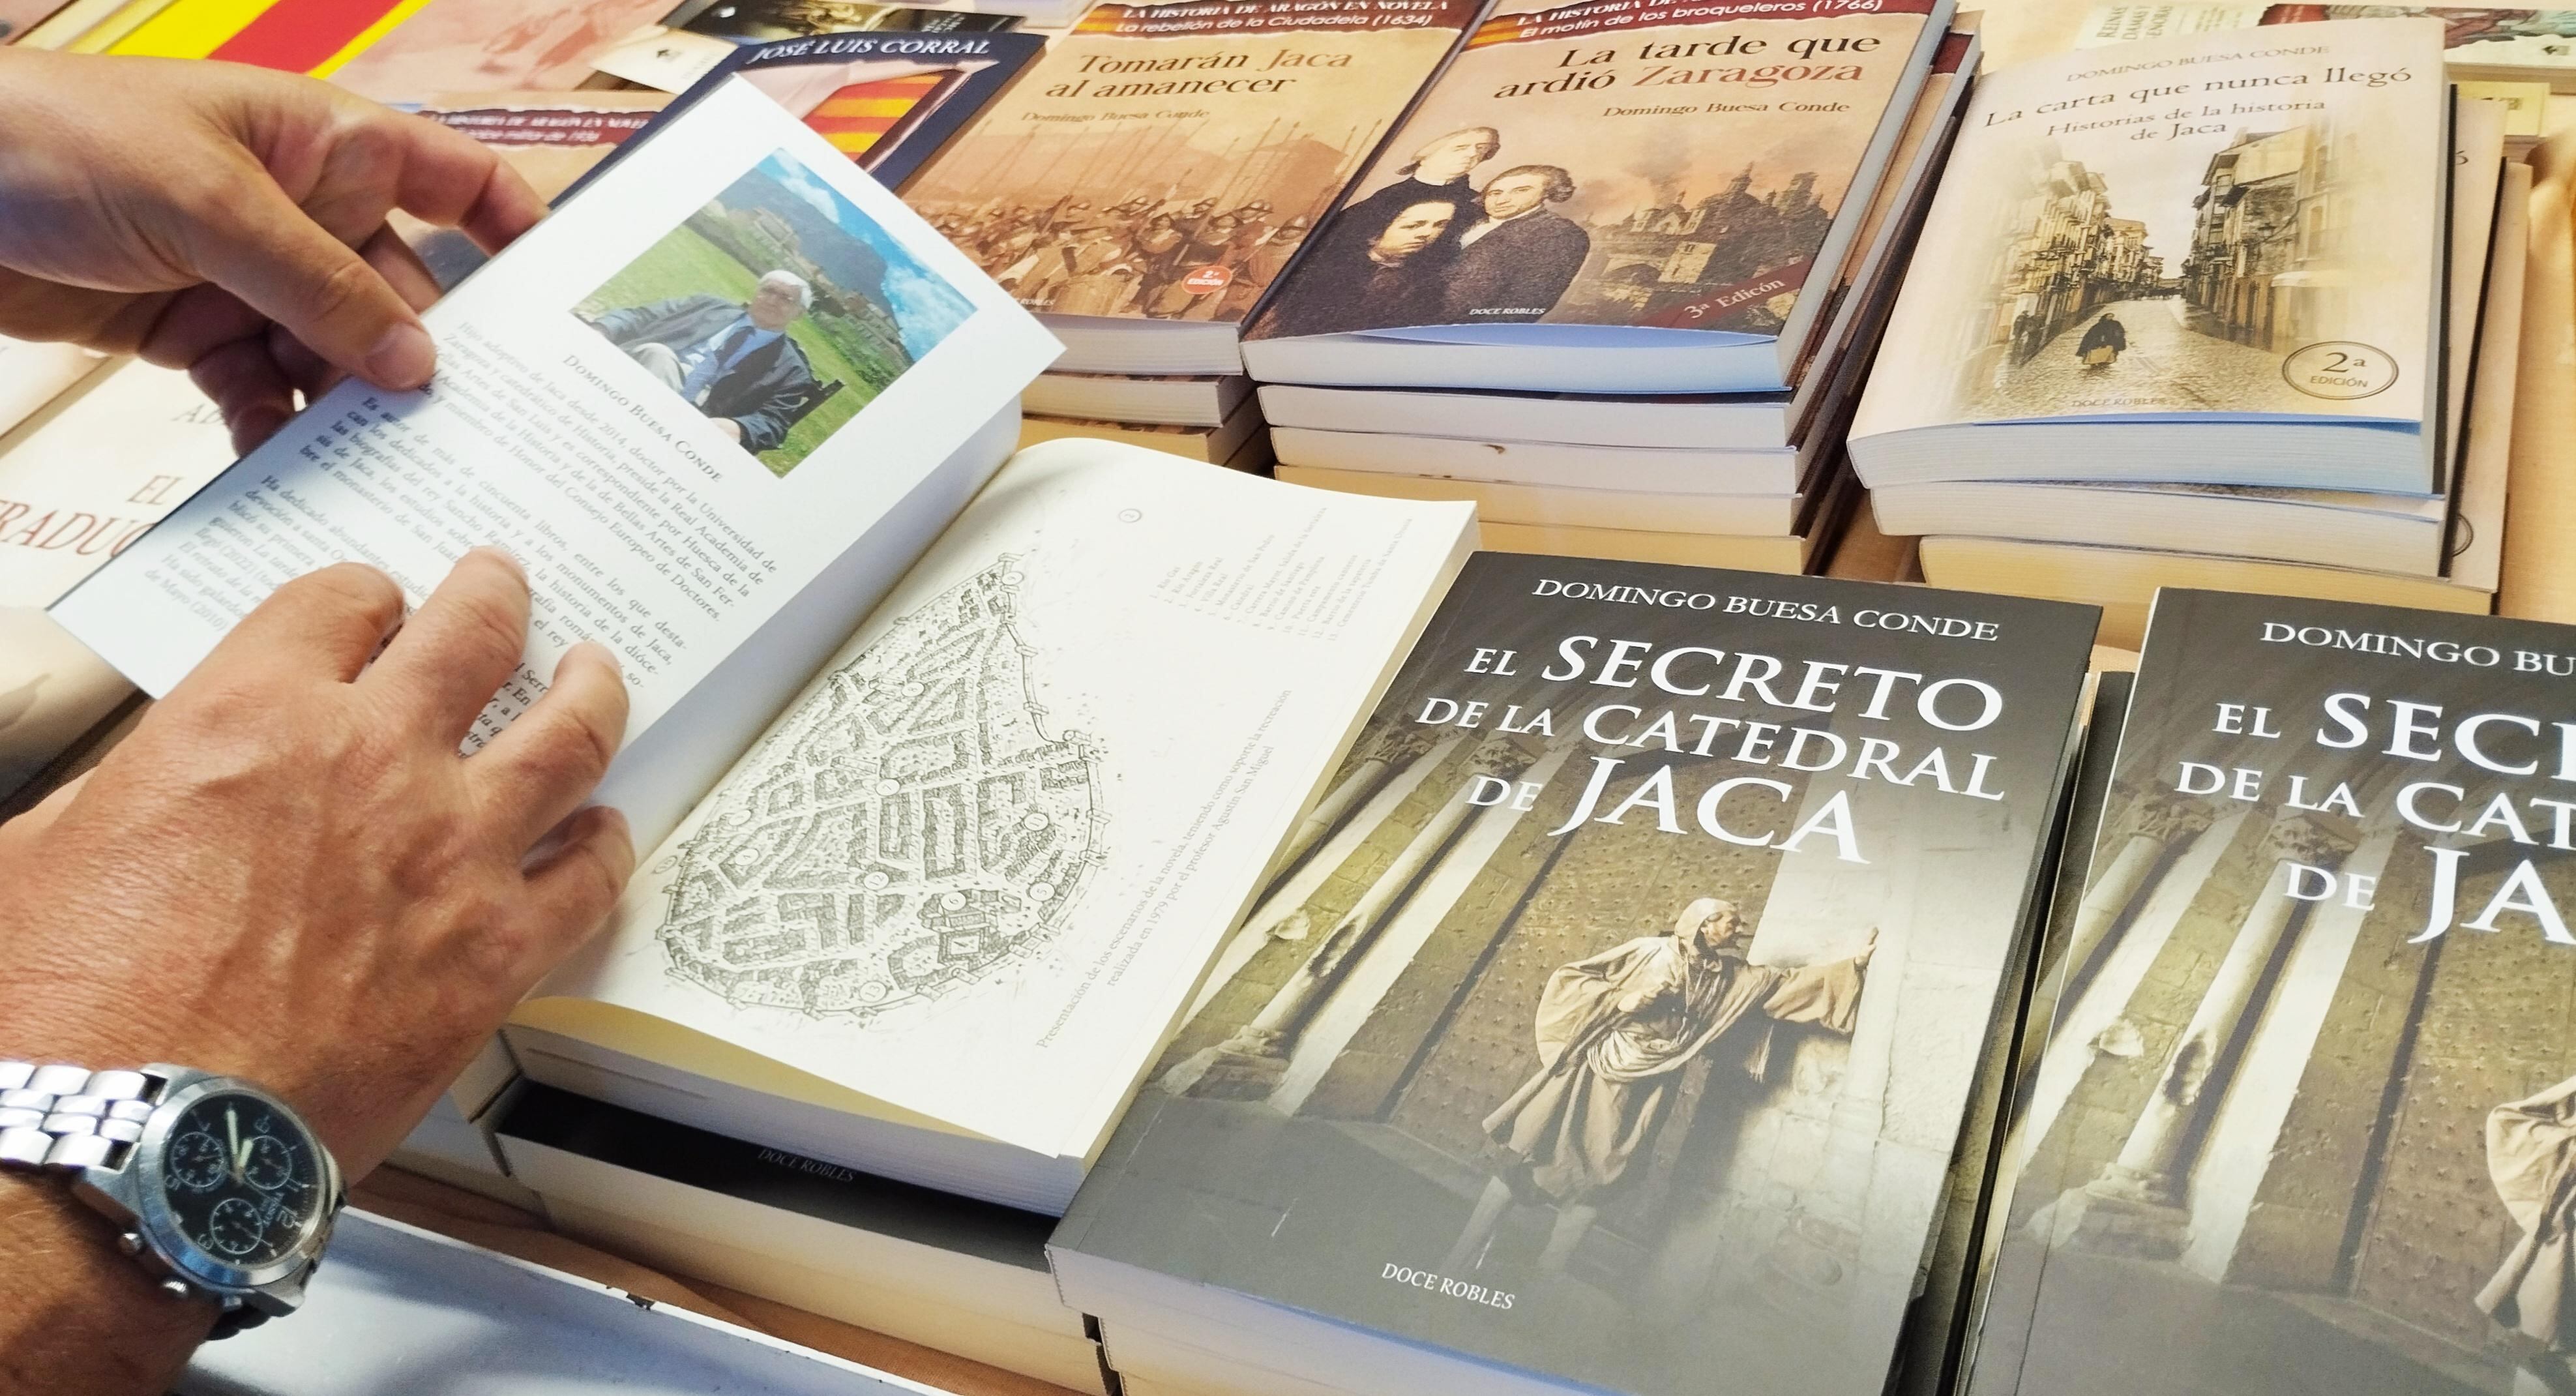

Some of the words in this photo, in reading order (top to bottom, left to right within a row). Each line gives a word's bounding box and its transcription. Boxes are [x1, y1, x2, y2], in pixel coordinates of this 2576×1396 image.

[1141, 20, 1213, 32] rebelión
[1217, 19, 1243, 28] de
[1245, 18, 1265, 27] la
[1268, 14, 1369, 26] Ciudadela
[1372, 14, 1432, 27] (1634)
[1151, 7, 1228, 18] HISTORIA
[1235, 5, 1262, 14] DE
[1344, 1, 1369, 10] EN
[1373, 1, 1447, 10] NOVELA
[1517, 14, 1542, 26] LA
[1548, 1, 1641, 22] HISTORIA
[1519, 27, 1539, 38] El
[1541, 20, 1599, 35] motín
[1604, 15, 1633, 26] de
[1638, 11, 1667, 22] los
[1672, 2, 1805, 18] broqueleros
[1812, 0, 1883, 12] (1766)
[746, 39, 815, 64] JOSÉ
[814, 39, 878, 53] LUIS
[880, 38, 990, 53] CORRAL
[1077, 52, 1250, 74] Tomarán
[1256, 49, 1354, 72] Jaca
[1556, 49, 1616, 68] La
[1638, 35, 1768, 60] tarde
[1787, 37, 1881, 59] que
[2066, 59, 2173, 82] DOMINGO
[2178, 52, 2243, 65] BUESA
[2249, 46, 2331, 59] CONDE
[1044, 80, 1090, 98] al
[1093, 77, 1297, 98] amanecer
[1493, 69, 1616, 98] ardió
[1631, 65, 1863, 88] Zaragoza
[1984, 110, 2023, 127] La
[2036, 93, 2115, 114] carta
[2129, 83, 2191, 104] que
[2204, 74, 2309, 91] nunca
[2324, 67, 2412, 88] llegó
[1020, 110, 1095, 123] Domingo
[1602, 105, 1698, 117] Domingo
[1706, 103, 1769, 113] Buesa
[1779, 101, 1850, 112] Conde
[2047, 112, 2155, 136] Historias
[2165, 108, 2192, 120] de
[2201, 106, 2221, 116] la
[2230, 99, 2327, 114] historia
[2130, 128, 2158, 141] de
[2166, 123, 2227, 141] Jaca
[1468, 307, 1501, 316] DOCE
[1502, 307, 1546, 316] ROBLES
[1684, 303, 1710, 319] 3ª
[1716, 278, 1785, 309] Edicón
[2322, 351, 2366, 374] 2ª
[2309, 375, 2369, 388] EDICIÓN
[563, 354, 629, 408] DOMINGO
[630, 400, 674, 443] BUESA
[674, 438, 724, 483] CONDE
[126, 475, 185, 506] EL
[576, 452, 661, 520] correspondiente
[657, 519, 683, 537] por
[681, 535, 722, 572] Huesca
[722, 572, 738, 586] de
[737, 584, 750, 597] la
[615, 462, 659, 495] preside
[657, 492, 670, 505] la
[670, 502, 699, 526] Real
[694, 526, 748, 572] Academia
[748, 572, 763, 585] de
[629, 447, 666, 477] doctor
[662, 476, 687, 494] por
[685, 492, 698, 505] la
[699, 502, 765, 560] Universidad
[761, 559, 777, 573] de
[0, 499, 158, 559] RADUC
[564, 486, 610, 524] Consejo
[608, 522, 655, 563] Europeo
[655, 563, 671, 576] de
[670, 573, 720, 621] Doctores.
[612, 501, 646, 531] Bellas
[645, 531, 676, 557] Artes
[675, 556, 692, 569] de
[690, 567, 713, 589] San
[712, 586, 733, 607] Fer-
[555, 563, 629, 624] monumentos
[630, 625, 646, 639] de
[645, 638, 672, 666] Jaca,
[1532, 578, 1715, 612] DOMINGO
[1723, 595, 1841, 625] BUESA
[1852, 608, 2000, 642] CONDE
[2260, 621, 2500, 668] DOMINGO
[1464, 647, 1517, 677] EL
[1541, 634, 2004, 733] SECRETO
[1257, 690, 1292, 732] recreación
[2212, 702, 2281, 739] EL
[1247, 733, 1263, 741] la
[1415, 697, 1487, 728] DE
[1494, 704, 1555, 737] LA
[1582, 704, 2006, 802] CATEDRAL
[1229, 742, 1256, 774] soporte
[1212, 775, 1234, 800] como
[1182, 801, 1215, 840] teniendo
[1466, 776, 1543, 812] DE
[1547, 755, 1871, 865] JACA
[2174, 761, 2263, 803] DE
[2284, 775, 2366, 818] LA
[2395, 780, 2576, 852] CAT
[1106, 942, 1144, 987] realizada
[1139, 927, 1153, 940] en
[1146, 900, 1168, 925] 1979
[1165, 882, 1183, 901] por
[1177, 871, 1191, 882] el
[1185, 832, 1216, 872] profesor
[1234, 778, 1254, 794] San
[1245, 745, 1275, 777] Miguel
[1160, 842, 1189, 875] novela,
[1142, 885, 1158, 898] de
[1149, 876, 1165, 885] la
[2283, 862, 2376, 912] DE
[2408, 845, 2576, 947] JA
[1108, 899, 1148, 950] escenarios
[1084, 967, 1101, 981] de
[1092, 951, 1113, 966] los
[1035, 982, 1091, 1048] Presentación
[758, 1148, 797, 1169] DOCE
[800, 1159, 853, 1183] ROBLES
[1381, 1262, 1438, 1291] DOCE
[1440, 1277, 1515, 1311] ROBLES
